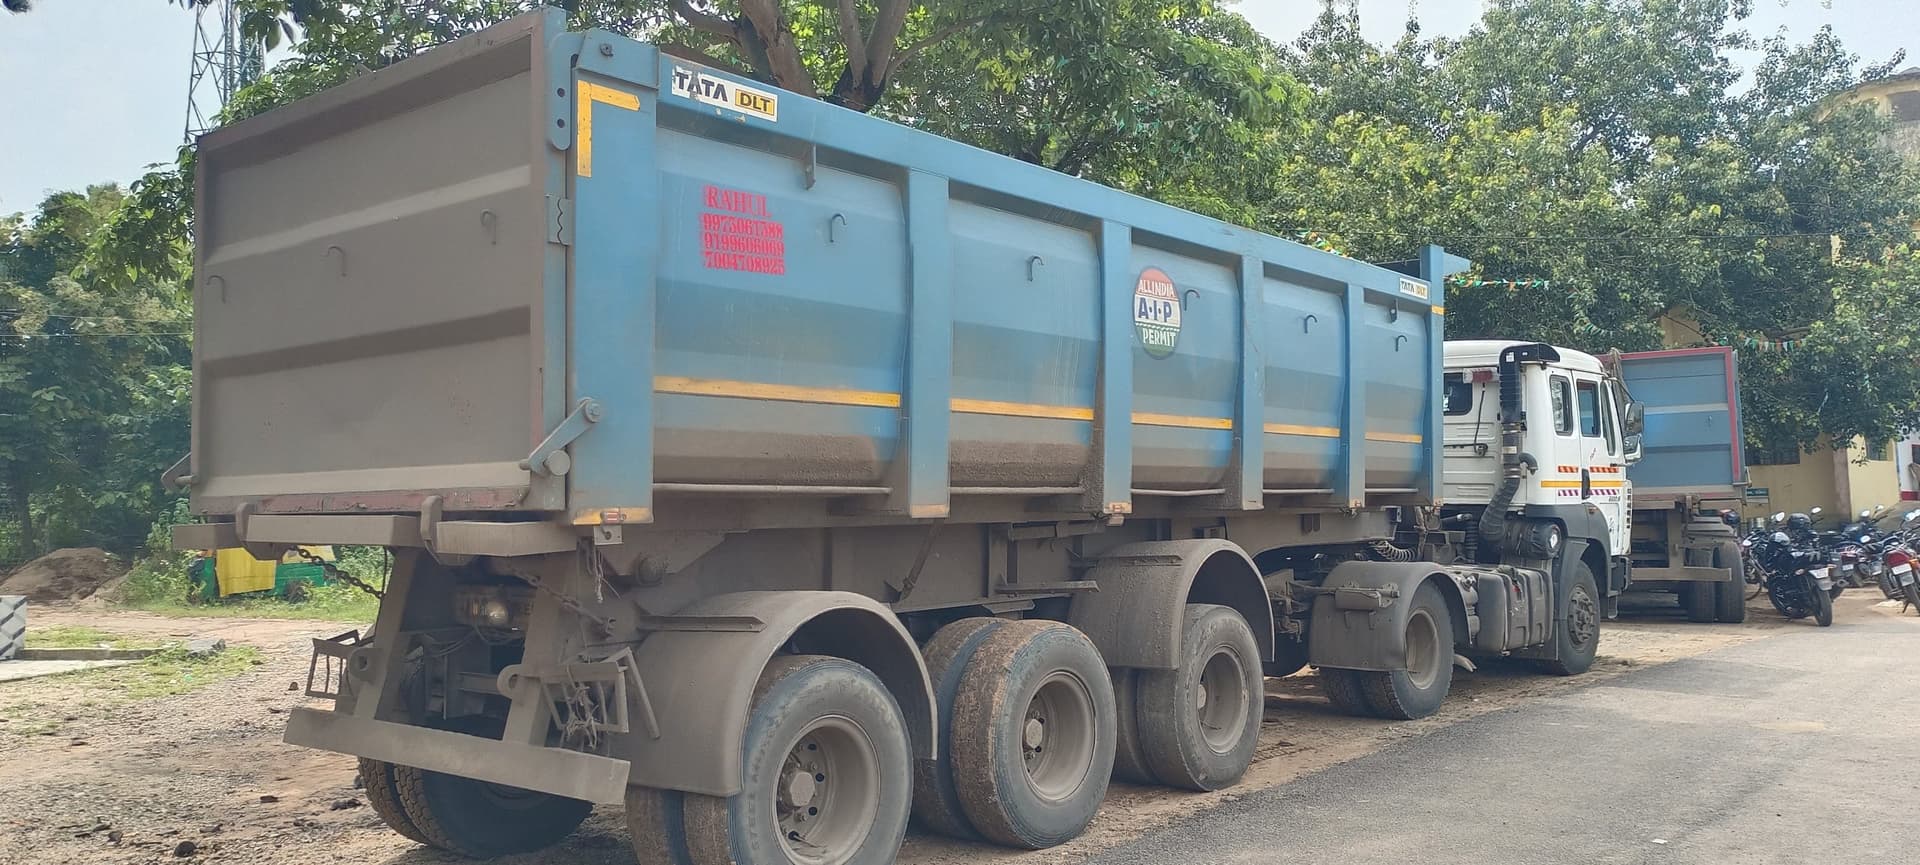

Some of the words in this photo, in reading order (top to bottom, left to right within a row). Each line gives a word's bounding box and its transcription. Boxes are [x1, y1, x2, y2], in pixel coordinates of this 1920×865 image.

[676, 72, 728, 102] TATA
[740, 92, 771, 113] DLT
[704, 184, 773, 218] RAHUL
[1400, 280, 1415, 294] TATA
[1142, 328, 1176, 347] PERMIT
